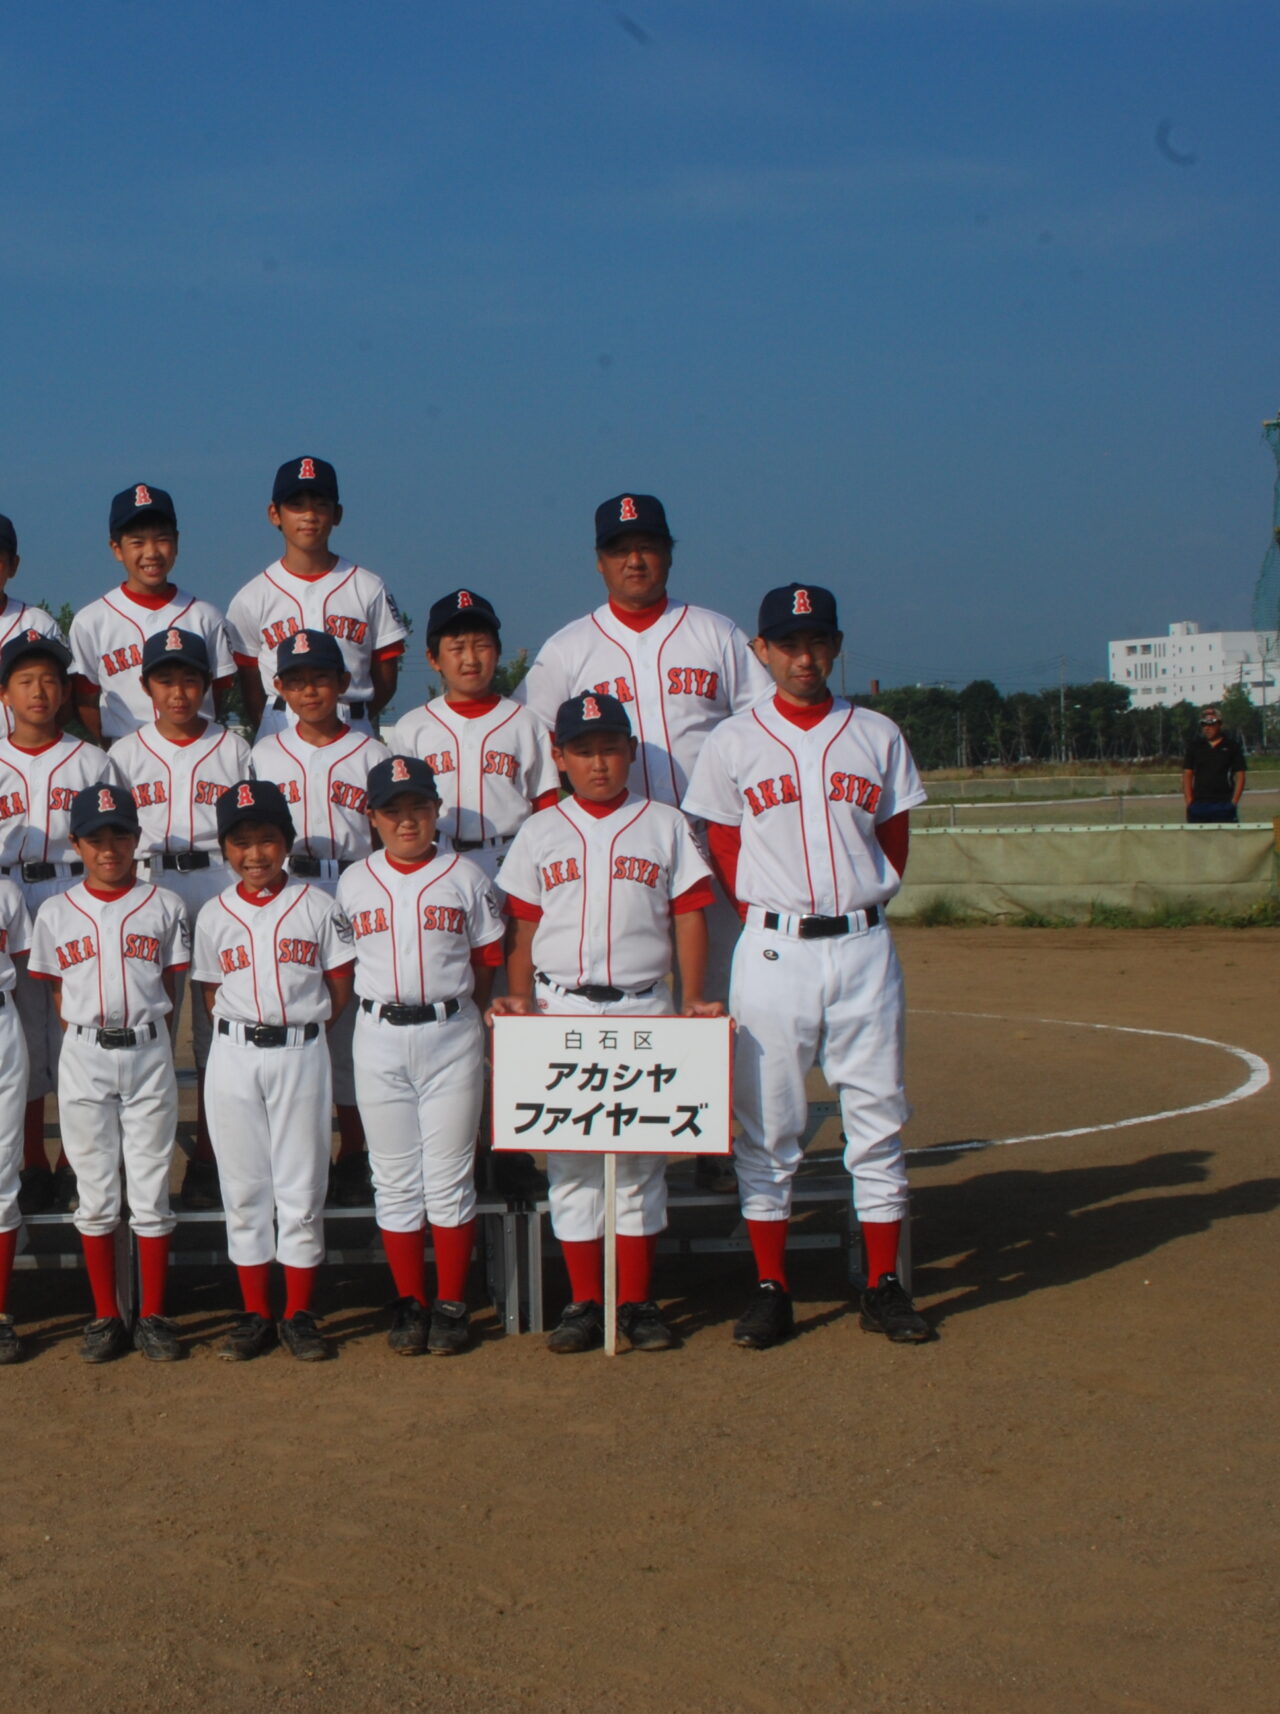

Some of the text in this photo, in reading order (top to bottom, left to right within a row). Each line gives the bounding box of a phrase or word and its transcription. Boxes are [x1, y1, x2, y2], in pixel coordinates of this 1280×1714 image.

[298, 458, 316, 479] A
[134, 484, 152, 506] A
[620, 497, 638, 521] A
[458, 591, 473, 609] A
[792, 589, 812, 614] A
[261, 615, 368, 650] AKA SIYA
[101, 644, 143, 677] AKA
[667, 667, 719, 700] SIYA
[582, 696, 601, 721] A
[391, 758, 411, 782] A
[98, 788, 116, 812] A
[237, 784, 255, 808] A
[744, 771, 882, 816] AKA SIYA
[542, 855, 660, 891] AKA SIYA
[55, 936, 96, 971] AKA
[219, 945, 252, 975] KA
[564, 1029, 653, 1050] 白石区
[545, 1062, 677, 1093] アカシヤ
[513, 1101, 709, 1137] ファイヤーズ
